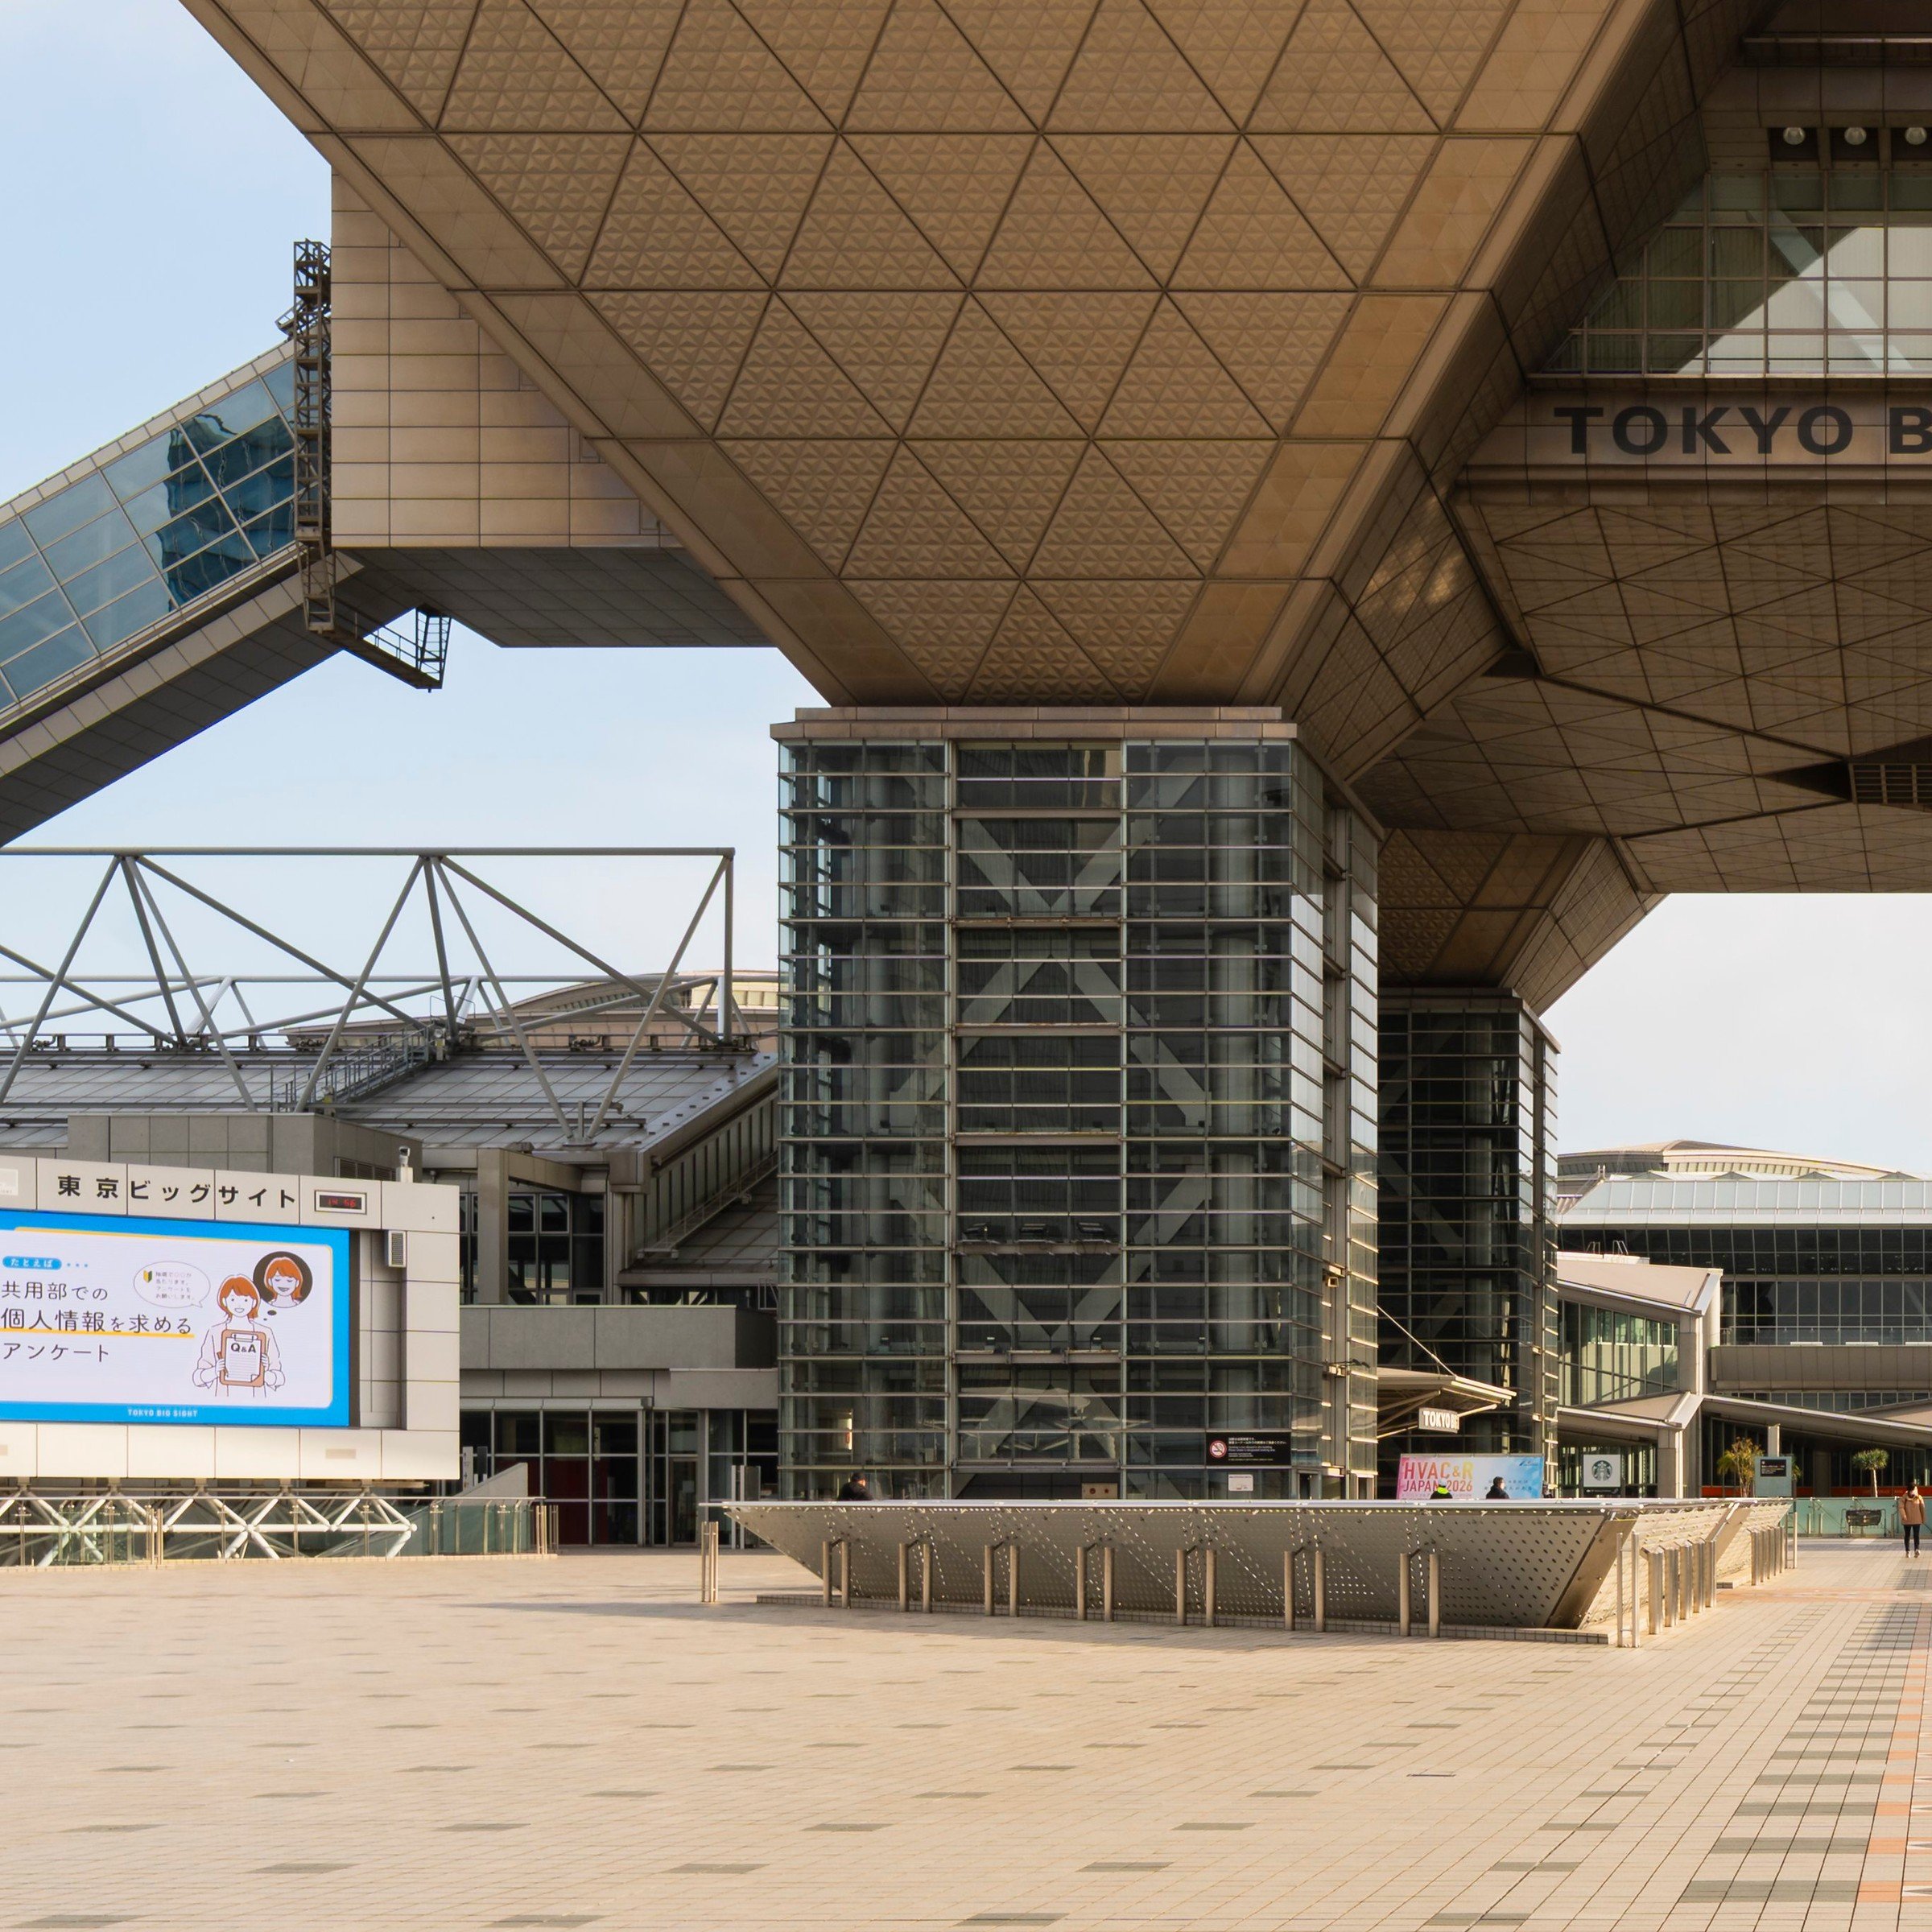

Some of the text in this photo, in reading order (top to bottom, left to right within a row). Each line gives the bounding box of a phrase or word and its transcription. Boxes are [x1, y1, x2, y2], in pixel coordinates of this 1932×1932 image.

[1554, 406, 1854, 455] TOKYO
[57, 1174, 295, 1209] 東京ビッグサイト
[2, 1280, 108, 1301] 共用部での
[1, 1308, 191, 1334] 個人情報を求める
[3, 1343, 109, 1362] アンケート
[230, 1343, 256, 1353] Q&A
[127, 1409, 155, 1417] TOKYO
[173, 1410, 199, 1418] SIGHT
[1422, 1410, 1451, 1428] TOKYO
[1447, 1480, 1472, 1492] 2026
